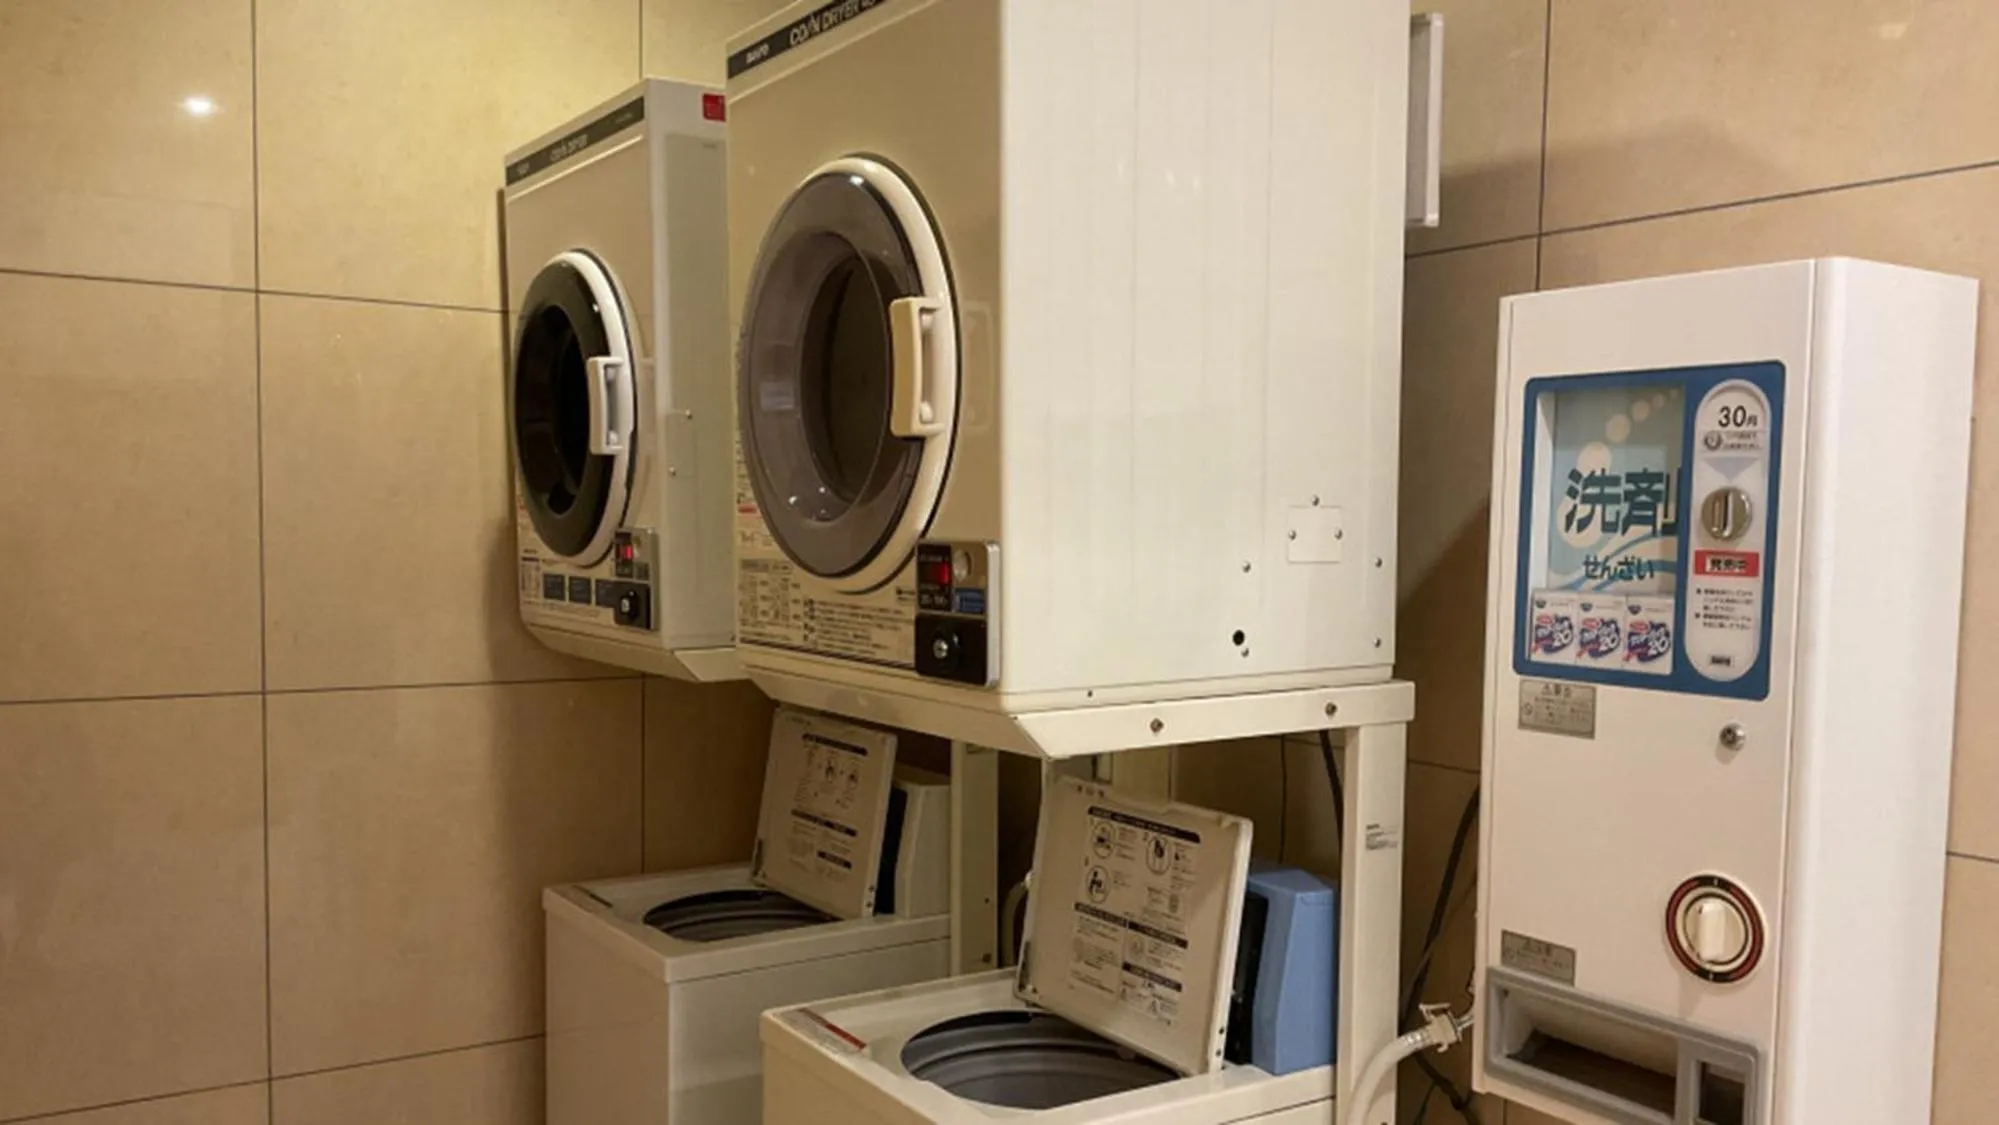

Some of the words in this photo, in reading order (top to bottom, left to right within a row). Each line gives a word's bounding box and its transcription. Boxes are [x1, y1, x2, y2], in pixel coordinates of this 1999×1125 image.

[790, 13, 821, 46] COIN
[822, 0, 860, 30] DRYER
[1565, 467, 1681, 537] 洗剤
[1582, 554, 1655, 581] せんざい
